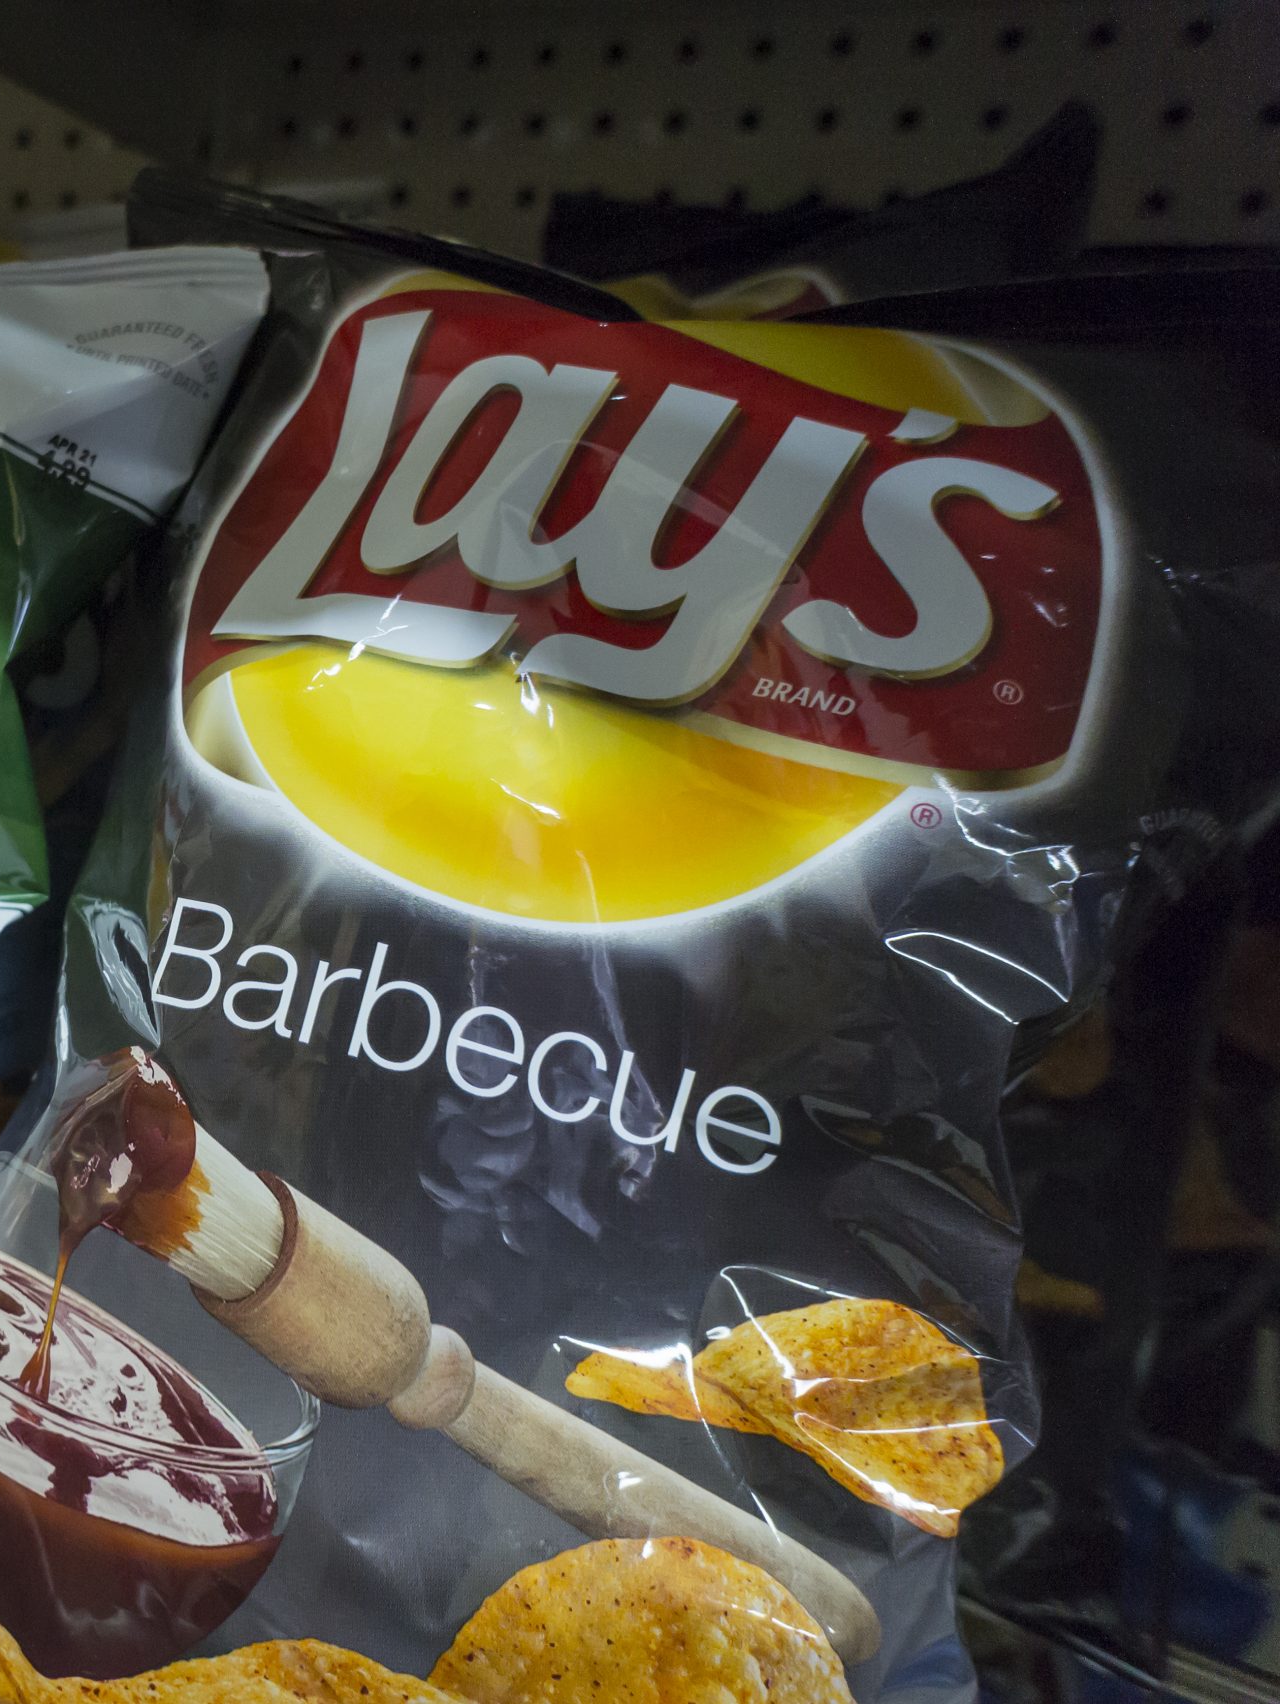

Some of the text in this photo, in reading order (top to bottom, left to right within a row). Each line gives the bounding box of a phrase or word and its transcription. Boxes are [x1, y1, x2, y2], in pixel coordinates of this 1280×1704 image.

[73, 321, 185, 345] GUARANTEED
[47, 434, 98, 467] APR 21
[211, 309, 1063, 708] Lay's
[751, 676, 856, 717] BRAND
[151, 897, 783, 1175] Barbecue
